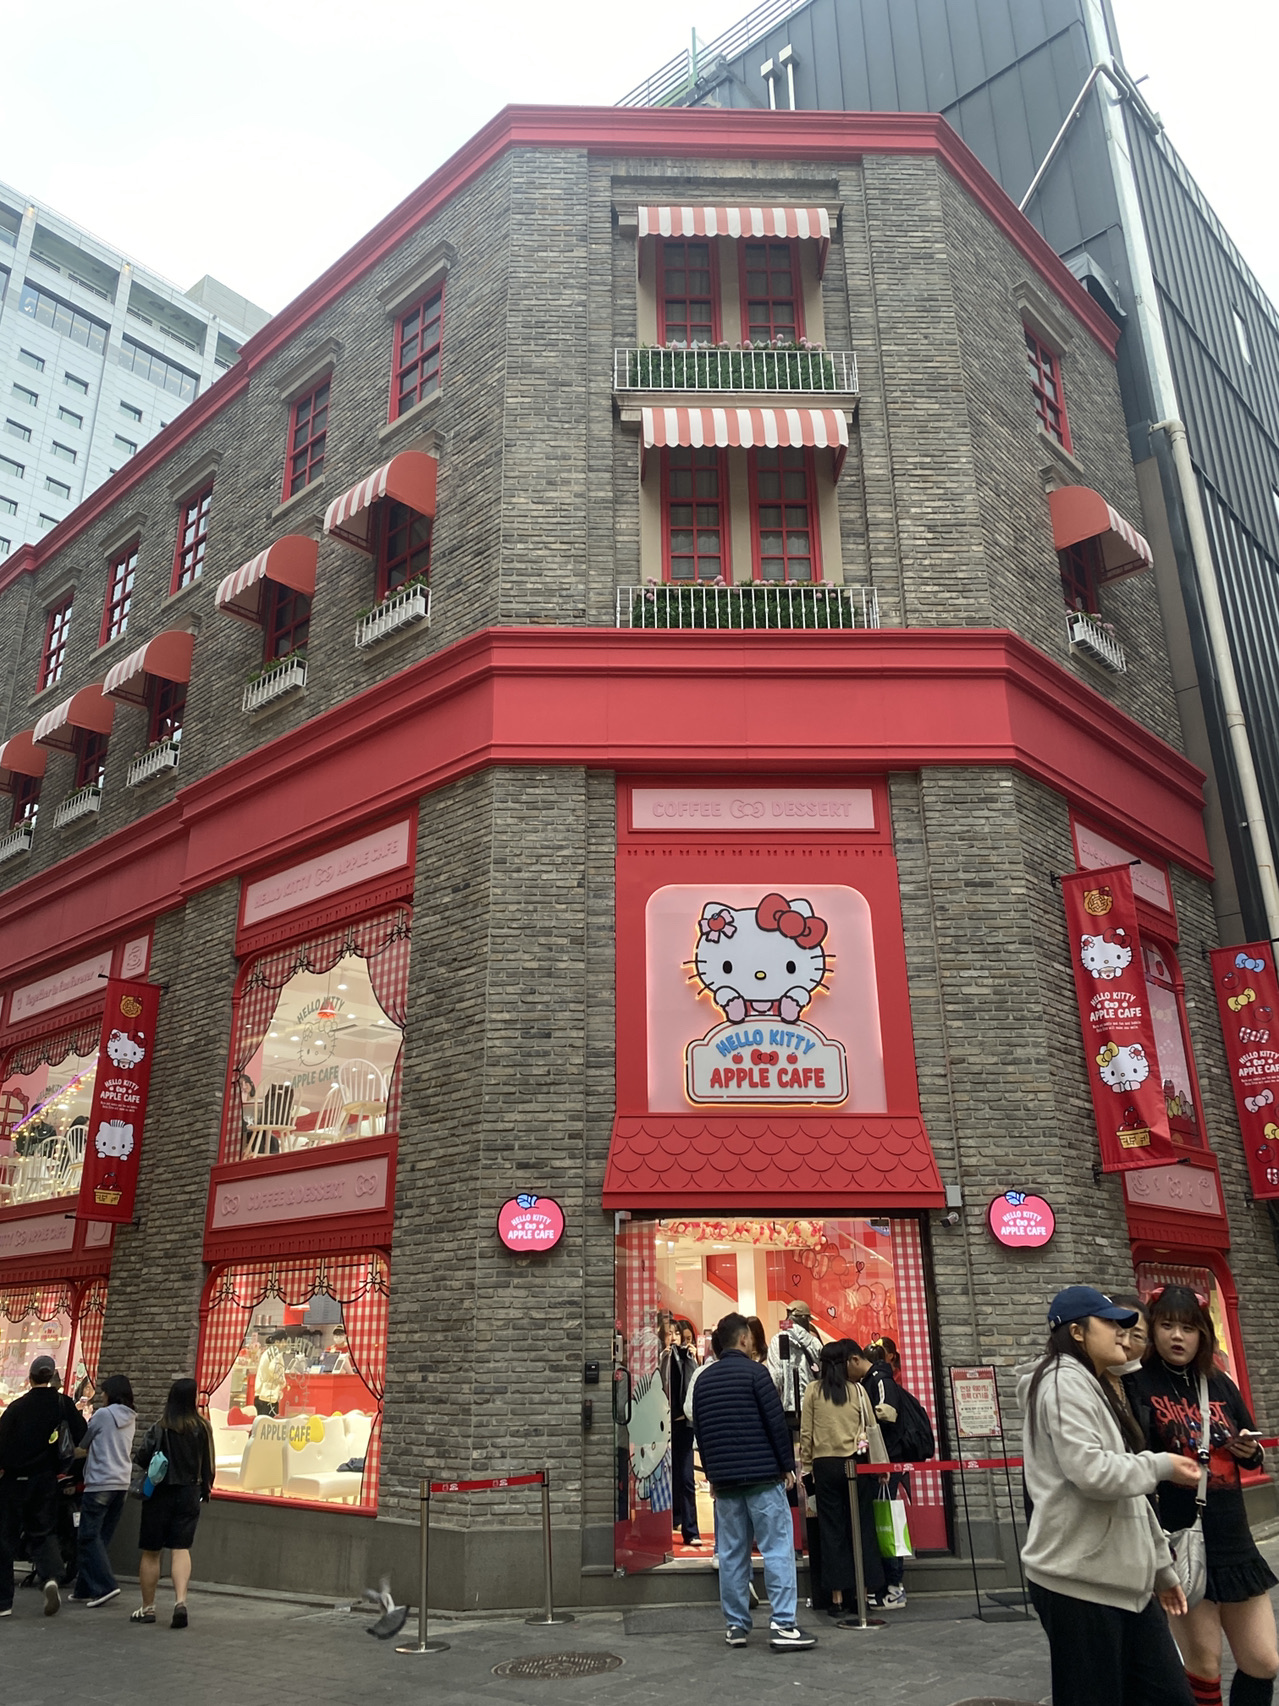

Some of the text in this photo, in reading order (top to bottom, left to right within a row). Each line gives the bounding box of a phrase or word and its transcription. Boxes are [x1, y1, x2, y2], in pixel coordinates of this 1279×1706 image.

[652, 800, 852, 817] COFFEE DESSERT
[283, 873, 312, 898] KITTY
[337, 851, 369, 877] APPLE
[371, 839, 399, 862] CAFE
[1090, 991, 1136, 1007] HELLO KITTY
[296, 998, 321, 1025] HELLO
[1090, 1007, 1142, 1022] APPLE CAFE
[716, 1029, 816, 1057] HELLO KITTY
[1239, 1051, 1258, 1064] HELLO
[291, 1065, 339, 1090] APPLE CAFE
[710, 1067, 825, 1088] APPLE CAFE
[1238, 1064, 1279, 1077] APPLE CAF
[104, 1079, 139, 1091] HELLO KITTY
[100, 1090, 140, 1104] APPLE CAFE
[247, 1187, 286, 1212] COFFEE
[296, 1178, 346, 1205] DESSERT
[511, 1214, 552, 1226] HELLO KITTY
[1002, 1211, 1042, 1222] HELLO KITTY
[507, 1230, 554, 1239] APPLE CAFE
[1000, 1226, 1047, 1236] APPLE CAFE
[260, 1424, 311, 1442] APPLE CAFE
